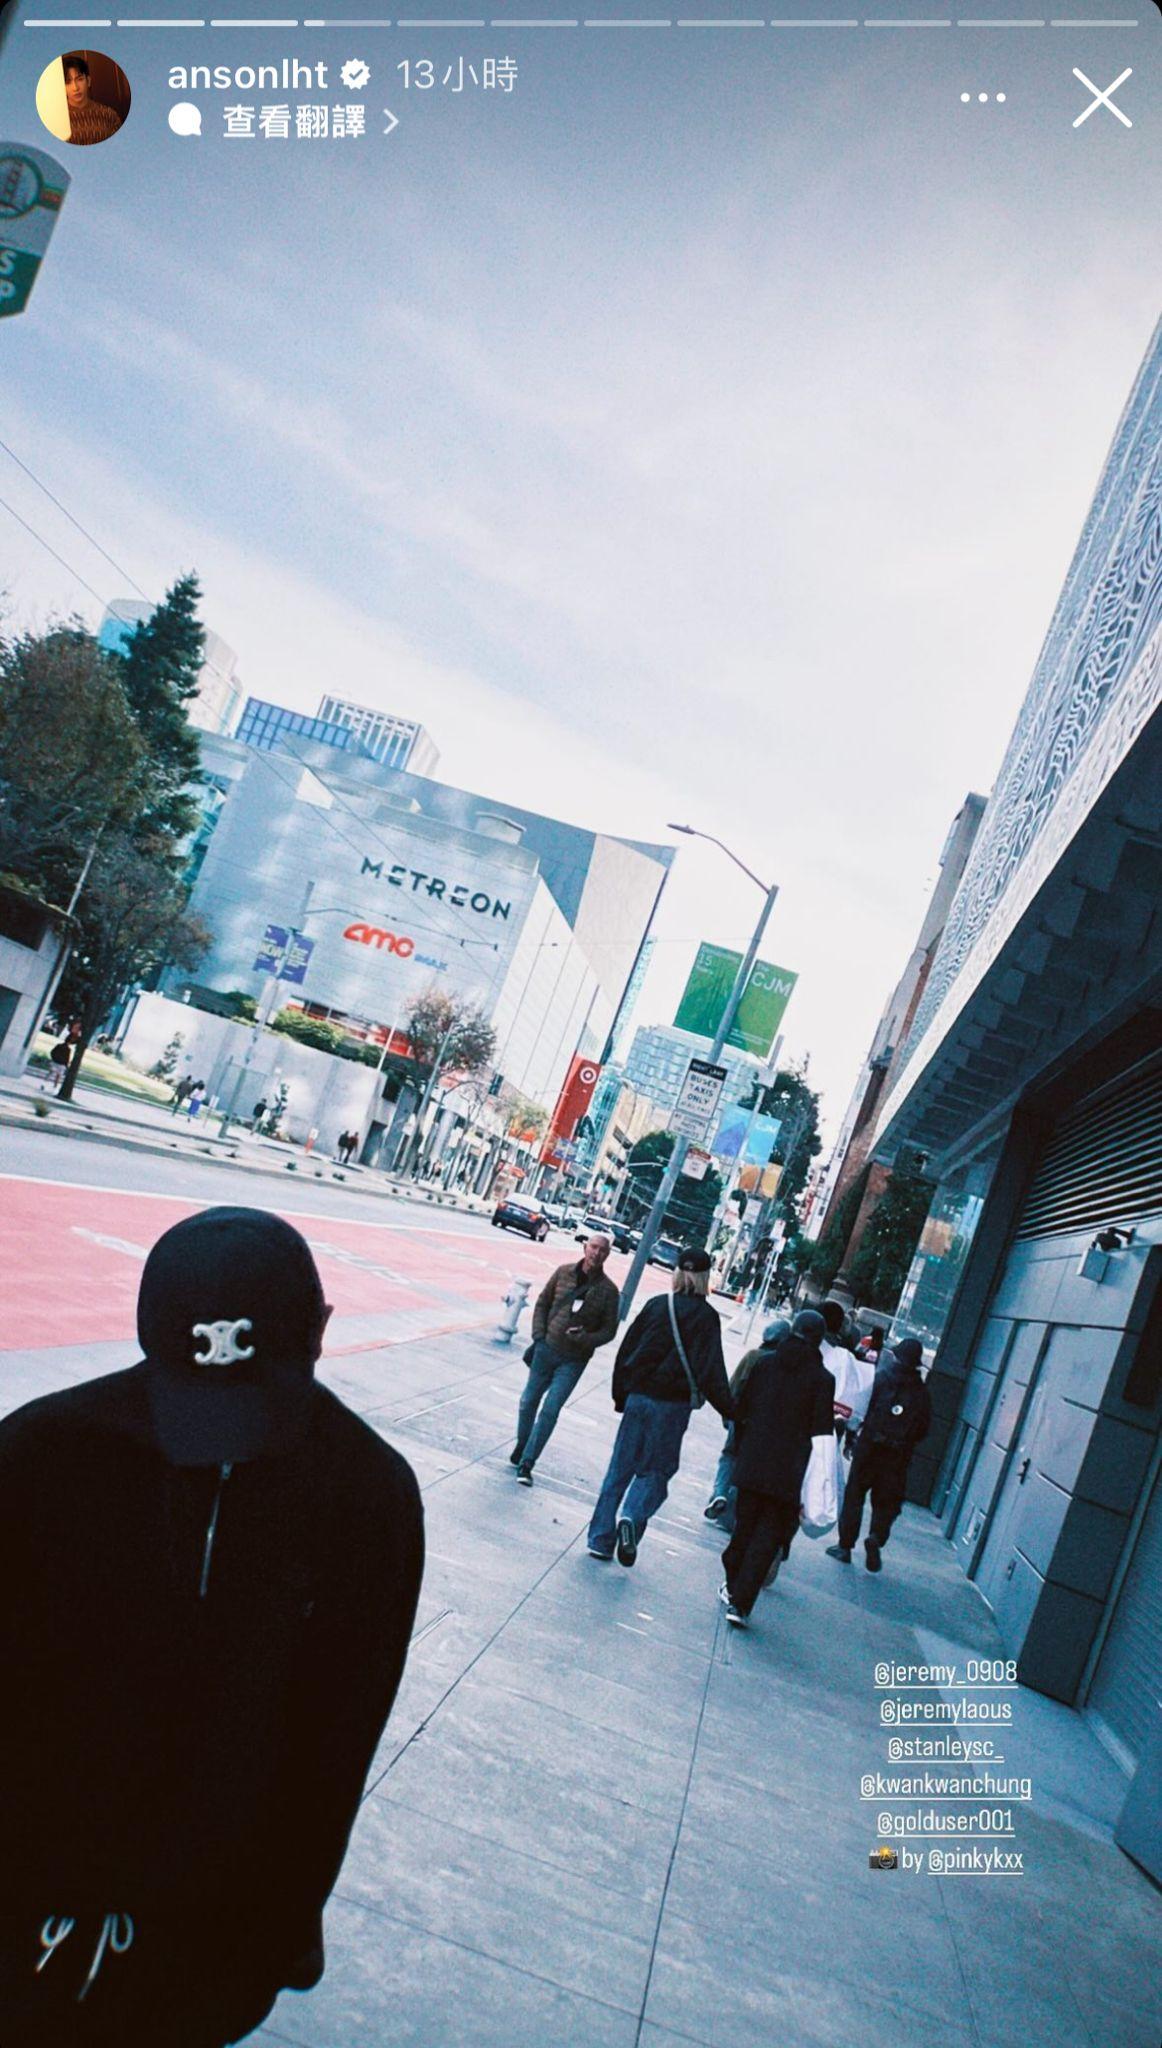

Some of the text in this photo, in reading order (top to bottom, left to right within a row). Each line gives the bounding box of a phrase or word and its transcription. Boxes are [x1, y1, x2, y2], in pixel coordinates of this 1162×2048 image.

[361, 856, 511, 920] METREON
[751, 971, 792, 998] CJM
[690, 1074, 718, 1089] BUSES
[689, 1082, 714, 1098] TAXIS
[687, 1093, 709, 1105] ONLY
